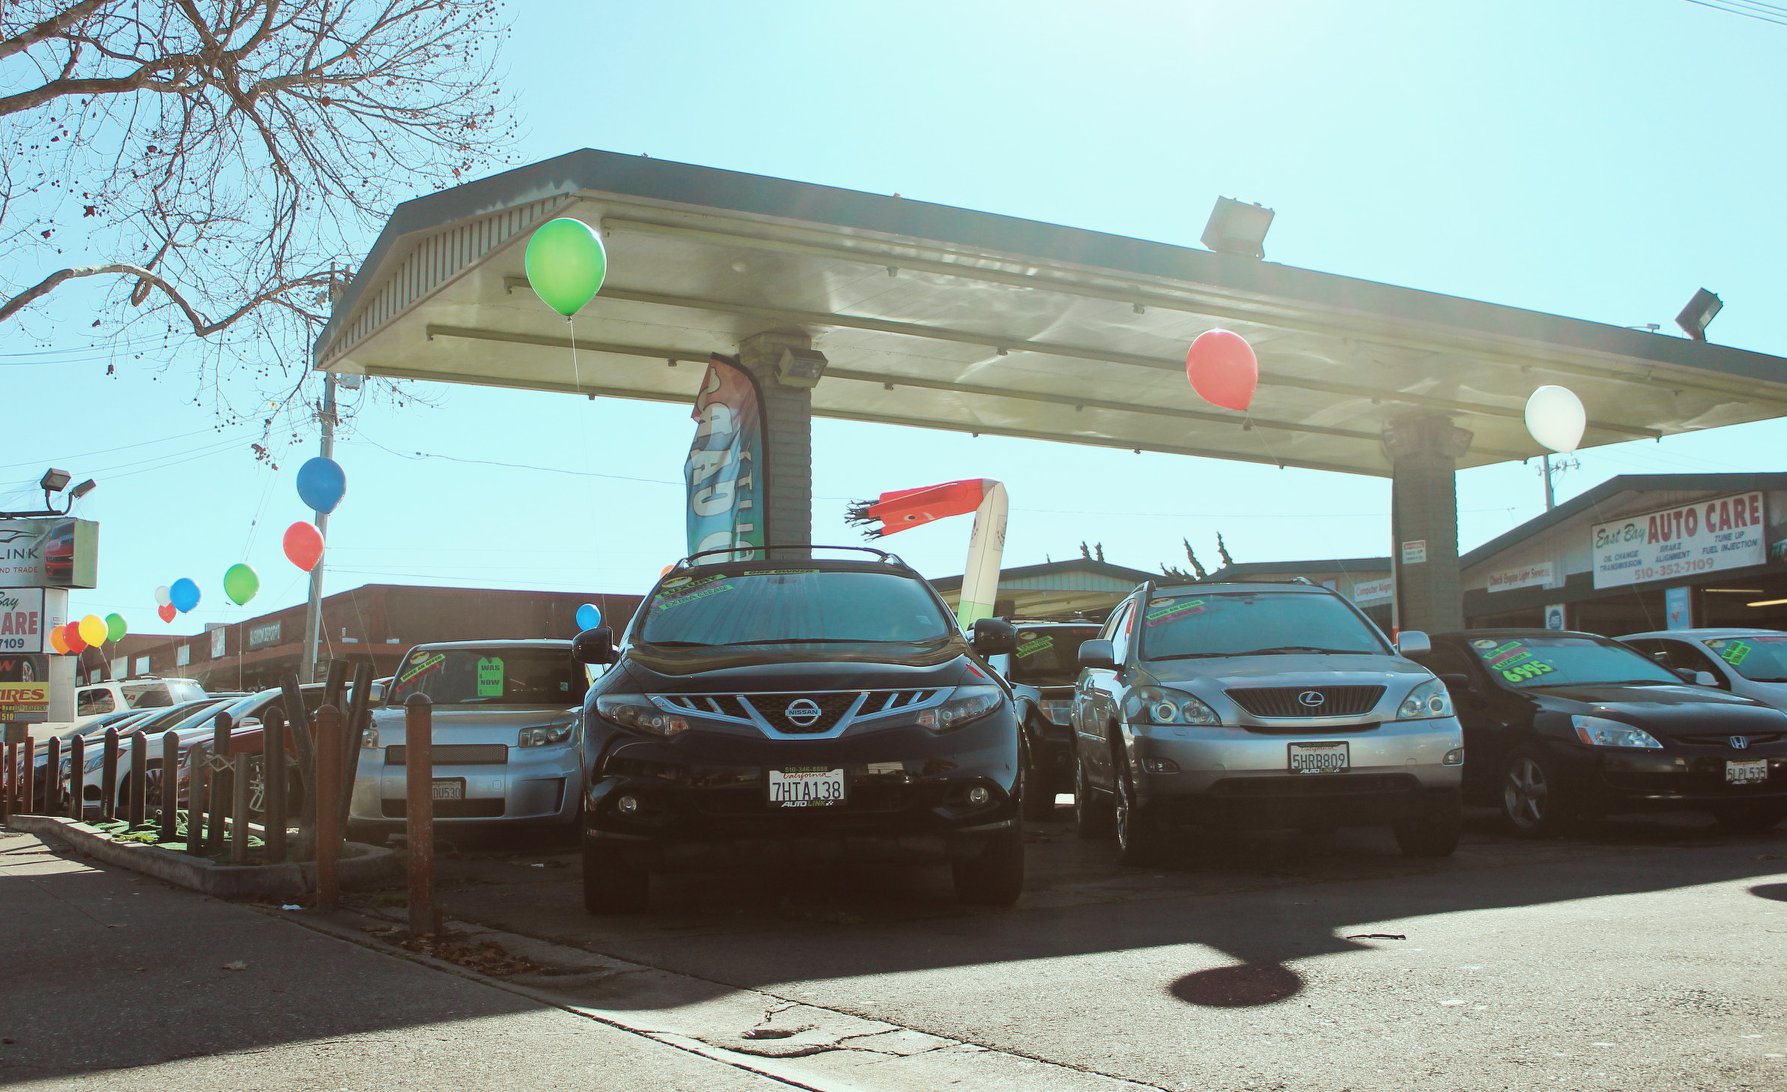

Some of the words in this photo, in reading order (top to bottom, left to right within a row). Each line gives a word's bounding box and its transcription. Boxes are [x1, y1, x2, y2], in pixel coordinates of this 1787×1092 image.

[1595, 528, 1620, 549] East
[1623, 523, 1646, 545] Bay
[1647, 507, 1698, 545] AUTO
[1705, 494, 1760, 533] CARE
[1714, 533, 1733, 543] TUNE
[1735, 530, 1745, 540] UP
[1660, 542, 1682, 553] BRAKE
[1701, 545, 1719, 555] FUEL
[1720, 539, 1758, 552] INJECTION
[1614, 550, 1639, 562] CHANGE
[1655, 550, 1691, 563] ALIGNMENT
[13, 566, 39, 574] TRADE
[1600, 558, 1642, 571] TRANSMISSION
[1634, 557, 1715, 580] 510-352-7109
[1502, 660, 1554, 683] 6995
[1293, 753, 1346, 769] 5HRB809
[783, 772, 831, 781] California
[772, 781, 841, 801] 7HTA138
